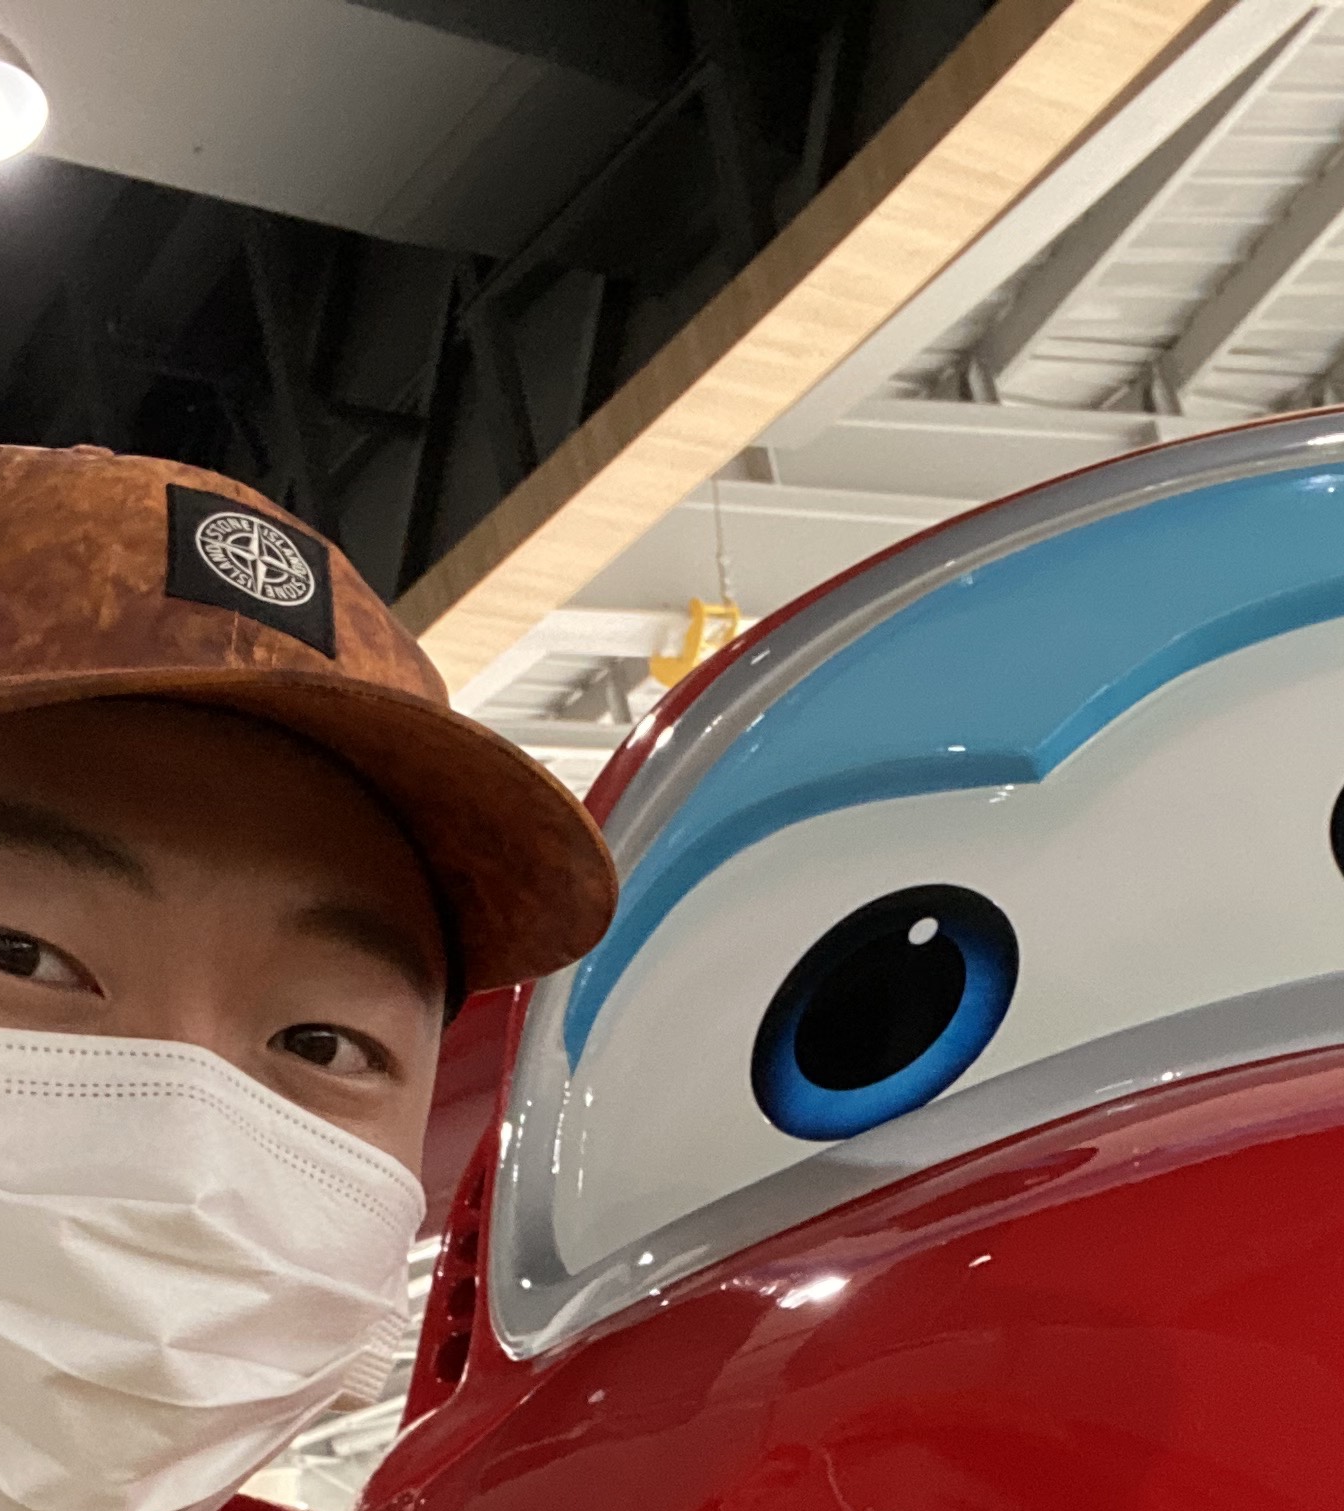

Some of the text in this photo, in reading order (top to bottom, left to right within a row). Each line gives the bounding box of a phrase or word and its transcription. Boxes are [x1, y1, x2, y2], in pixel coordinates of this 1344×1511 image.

[205, 518, 308, 577] STONE ISLAND
[205, 542, 254, 589] ISLAND
